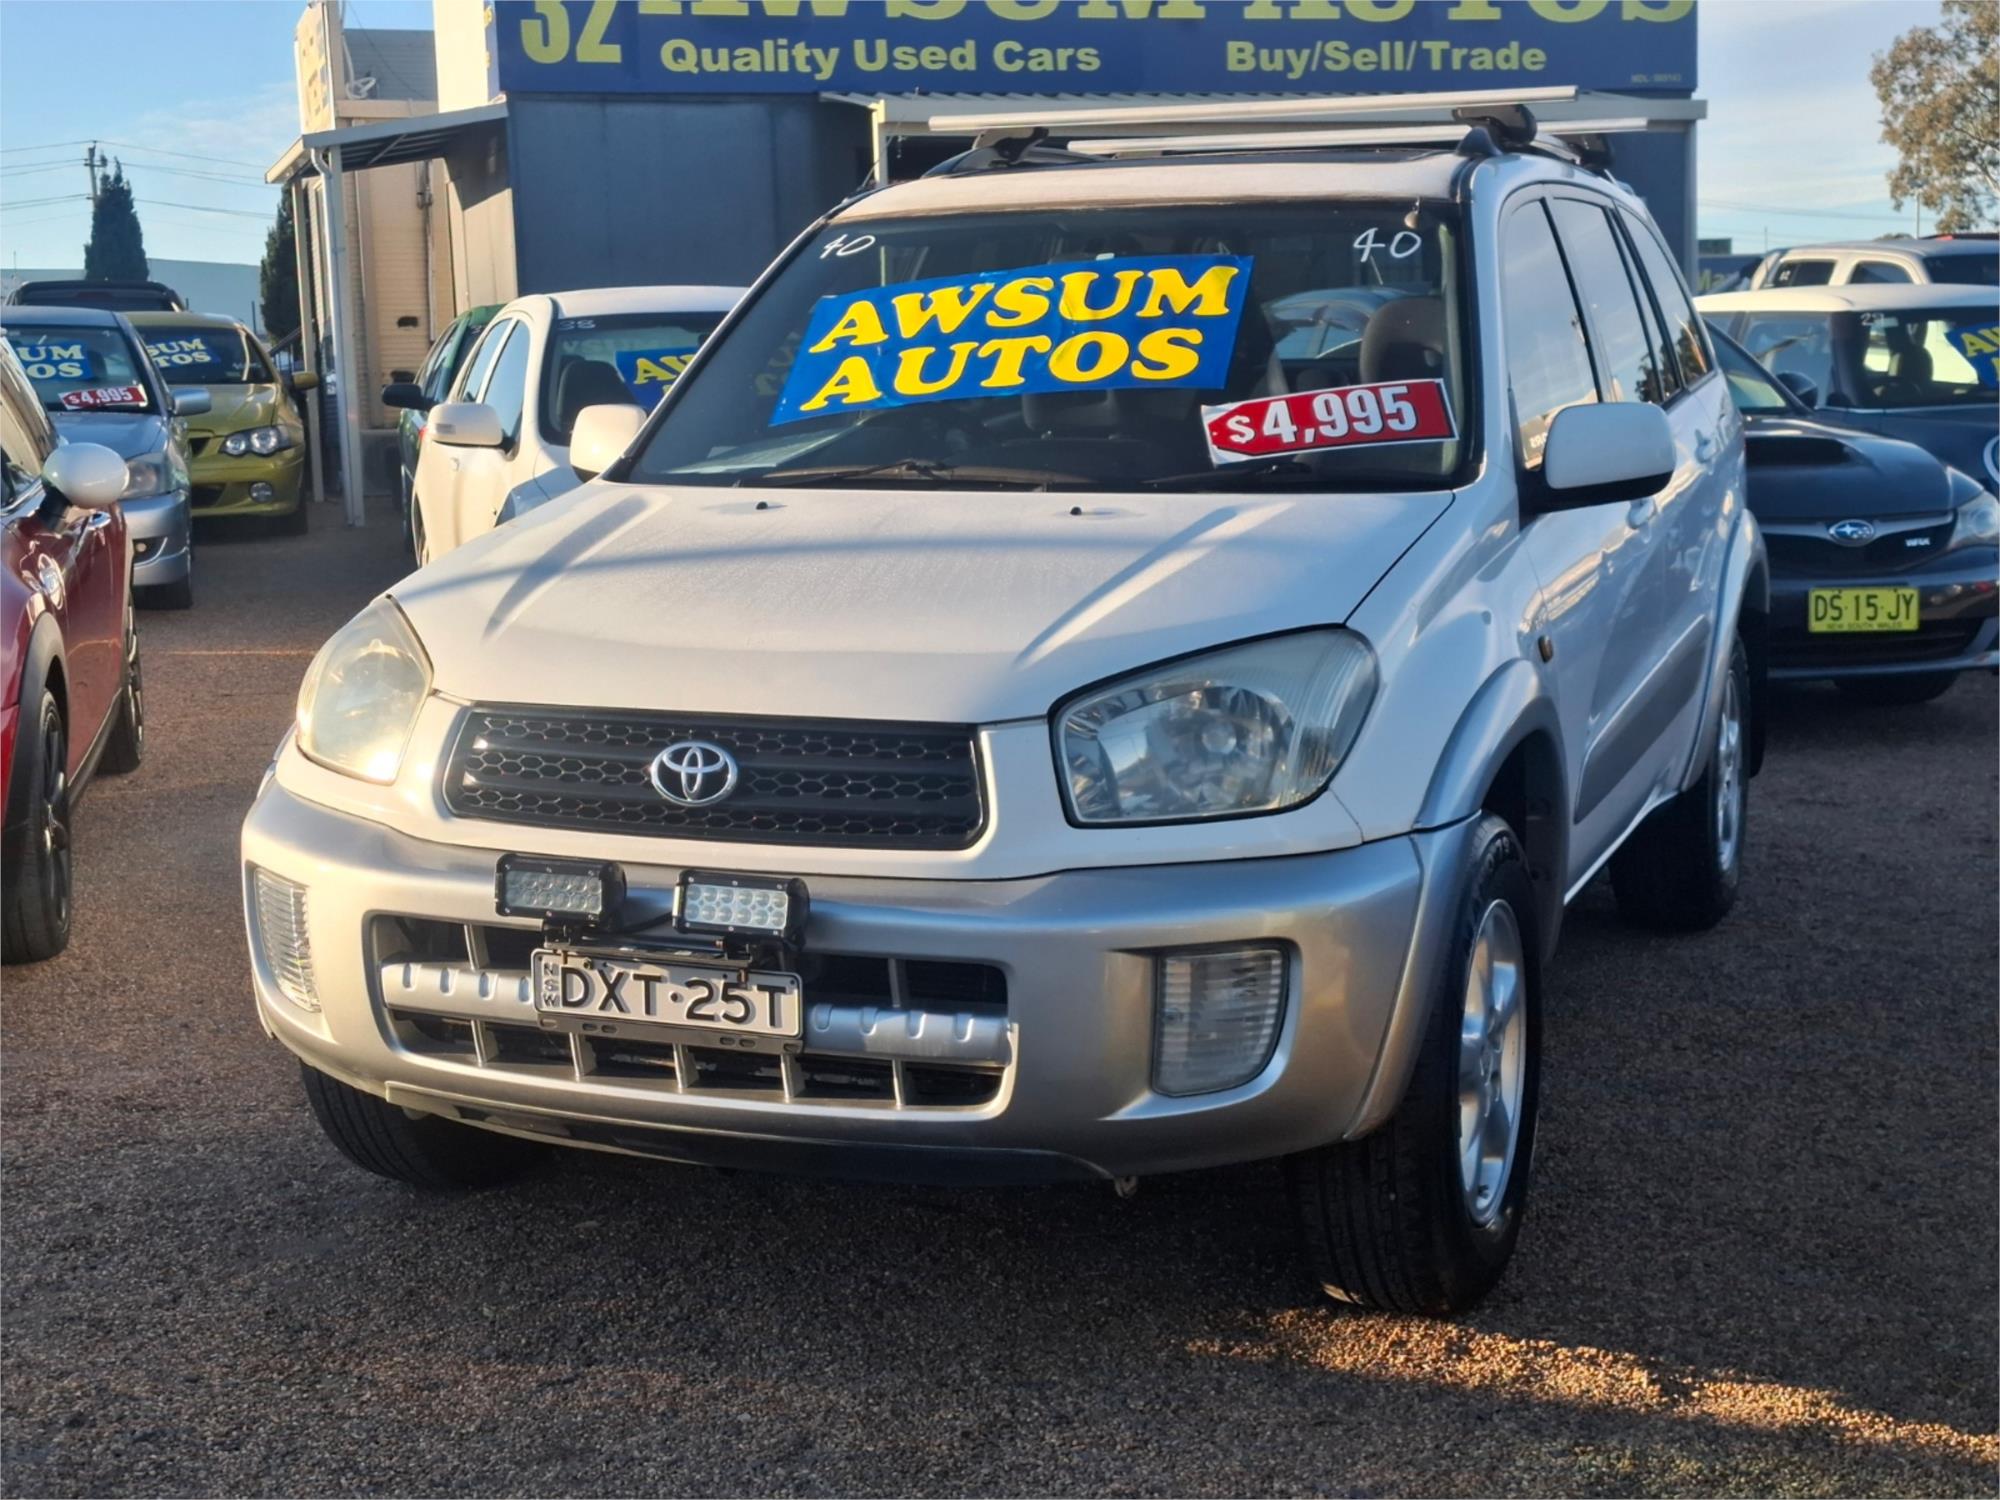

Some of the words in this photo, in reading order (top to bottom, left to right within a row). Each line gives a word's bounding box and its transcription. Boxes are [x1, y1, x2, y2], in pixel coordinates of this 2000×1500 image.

[660, 38, 839, 80] Quality
[853, 39, 976, 71] Used
[993, 40, 1101, 72] Cars
[1226, 40, 1547, 79] Buy/Sell/Trade
[819, 233, 876, 259] 40
[1353, 228, 1421, 262] 40
[809, 265, 1239, 353] AWSUM
[800, 328, 1203, 411] AUTOS
[1226, 386, 1418, 443] $4,995
